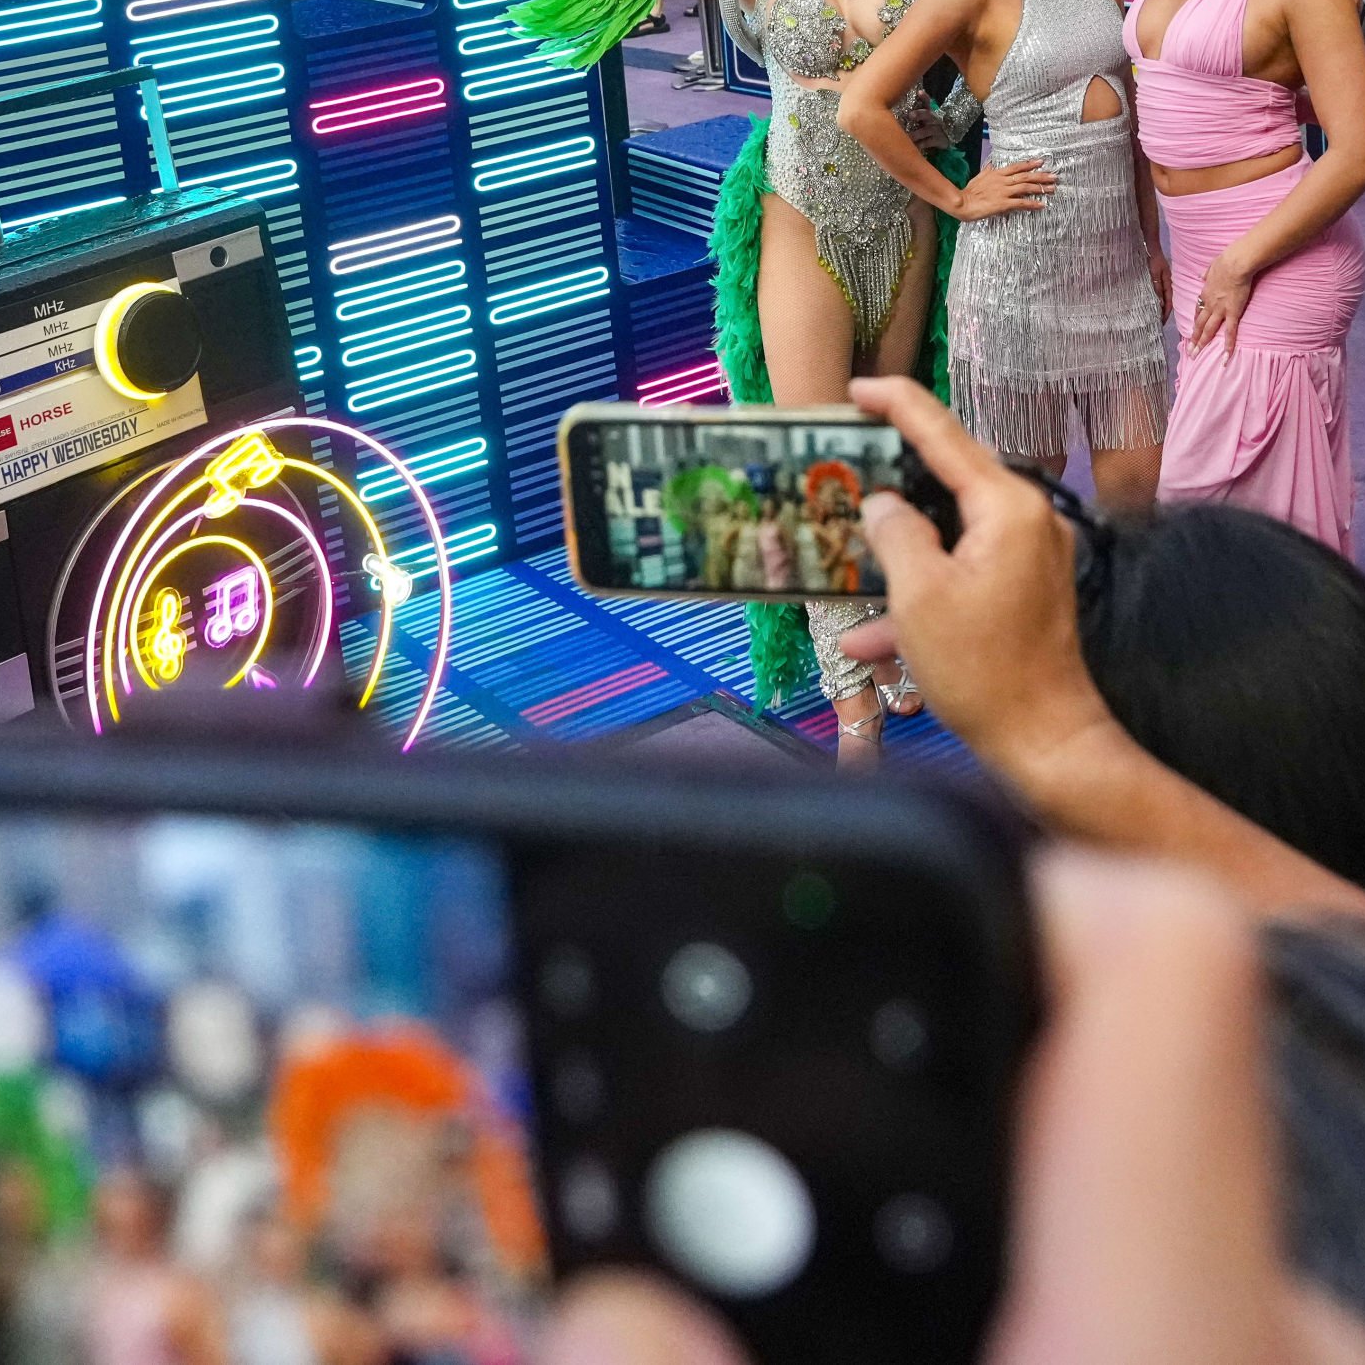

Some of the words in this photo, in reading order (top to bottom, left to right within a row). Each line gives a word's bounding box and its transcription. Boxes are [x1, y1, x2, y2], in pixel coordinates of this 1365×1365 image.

[33, 299, 66, 319] MHz
[43, 320, 69, 336] MHz
[47, 342, 74, 358] MHz
[54, 357, 77, 373] KHz
[19, 402, 73, 431] HORSE
[1, 450, 48, 485] HAPPY
[52, 417, 139, 464] WEDNESDAY
